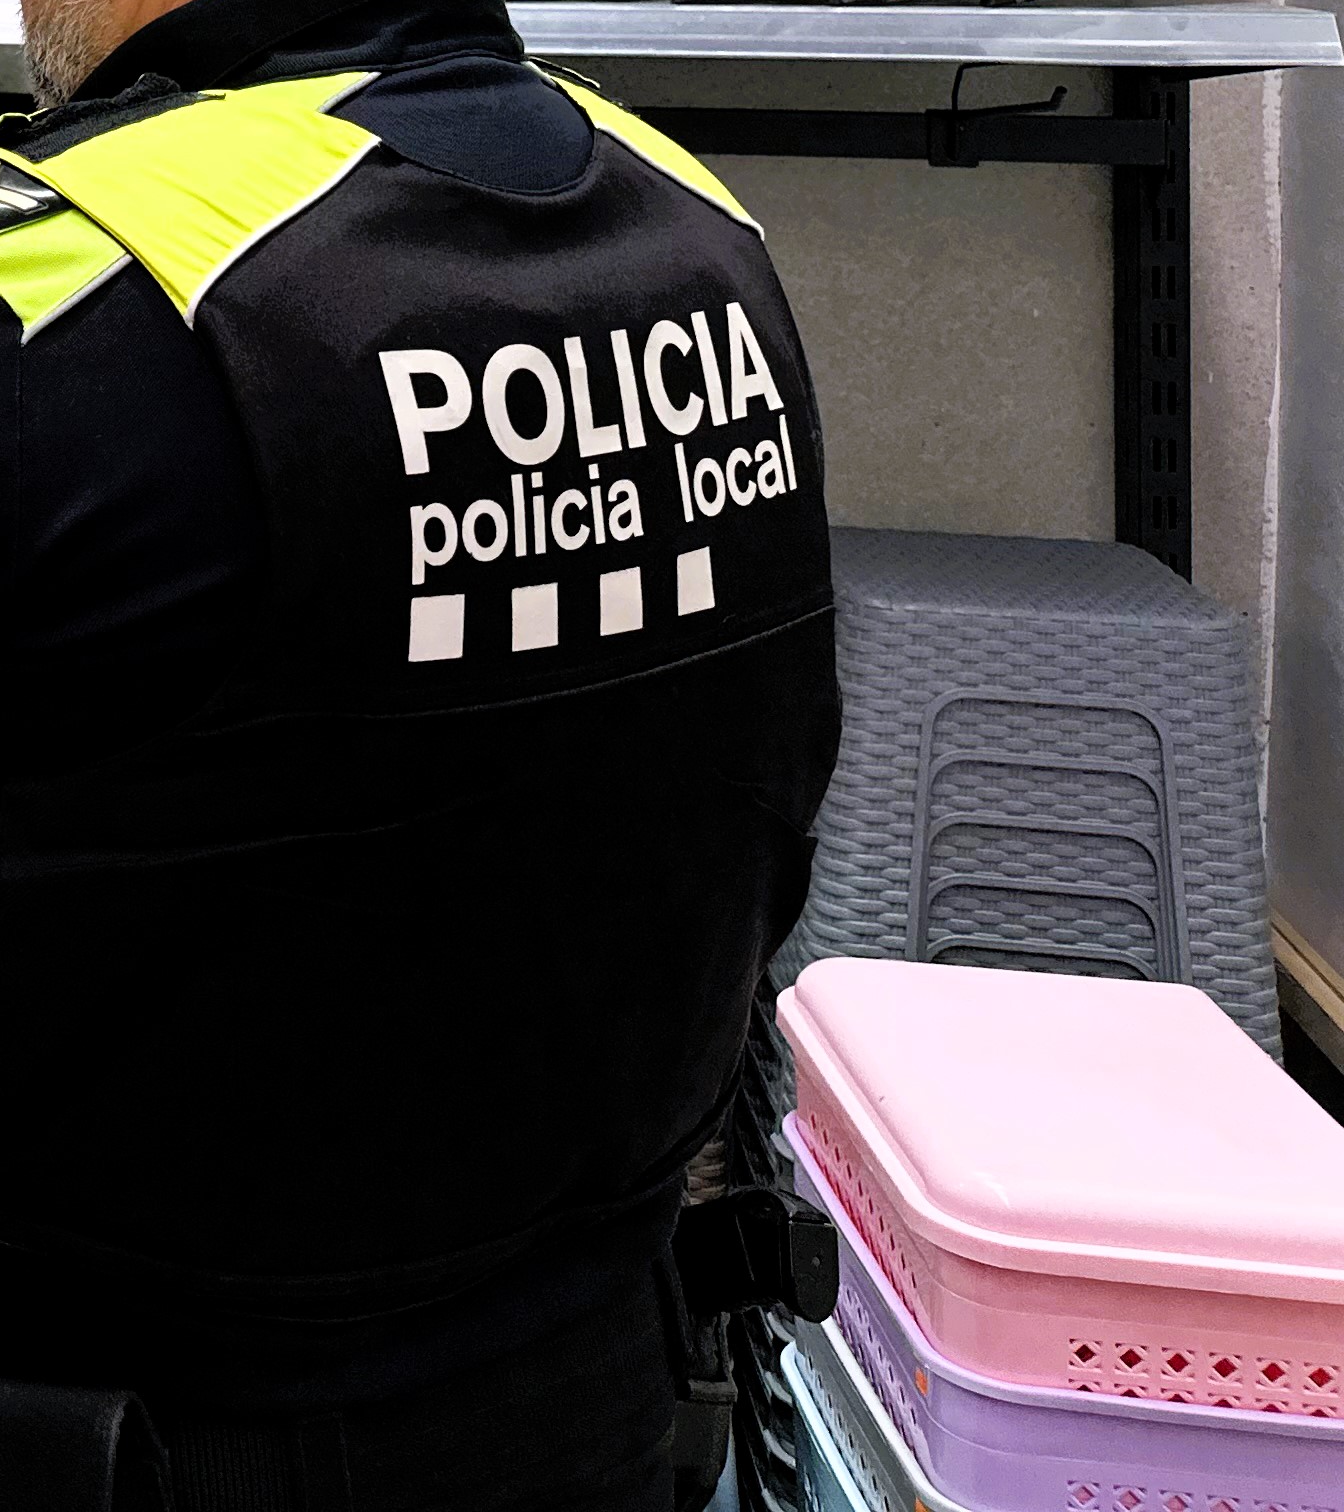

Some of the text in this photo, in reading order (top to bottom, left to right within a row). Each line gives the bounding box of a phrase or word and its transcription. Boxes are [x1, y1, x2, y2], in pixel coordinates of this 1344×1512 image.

[378, 302, 784, 475] POLICIA
[410, 414, 798, 585] policia local
